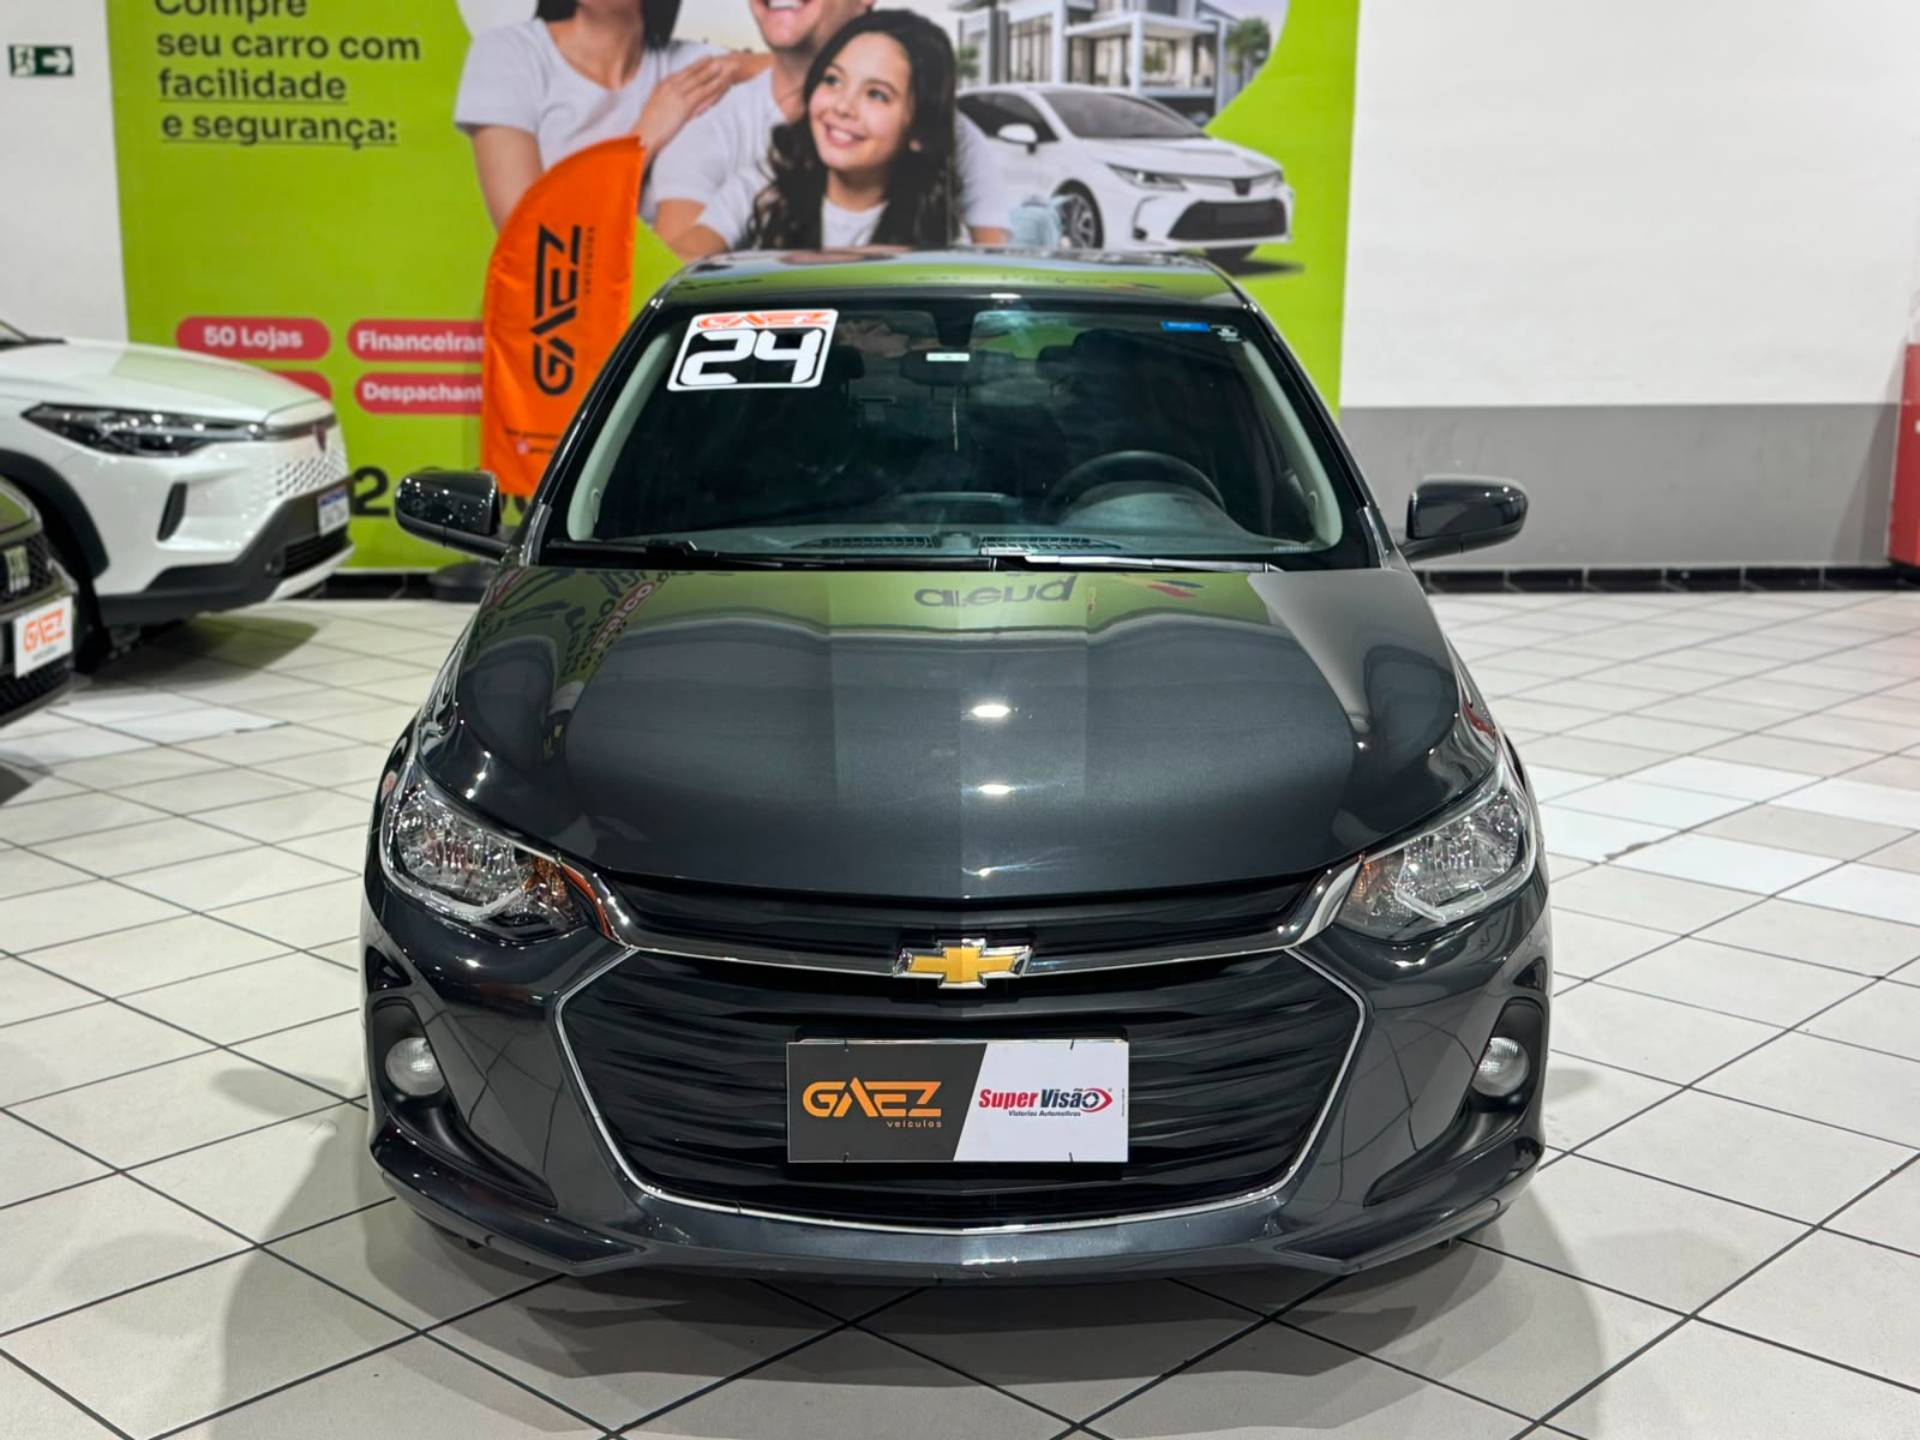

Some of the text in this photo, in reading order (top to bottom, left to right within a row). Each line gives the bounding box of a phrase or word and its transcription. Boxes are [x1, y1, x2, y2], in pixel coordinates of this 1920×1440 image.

[157, 32, 421, 61] seu carro com
[158, 67, 347, 100] facilidade
[162, 113, 397, 151] e segurança:
[204, 326, 303, 352] 50 Lojas
[679, 328, 824, 386] 24
[979, 1088, 1039, 1110] Super
